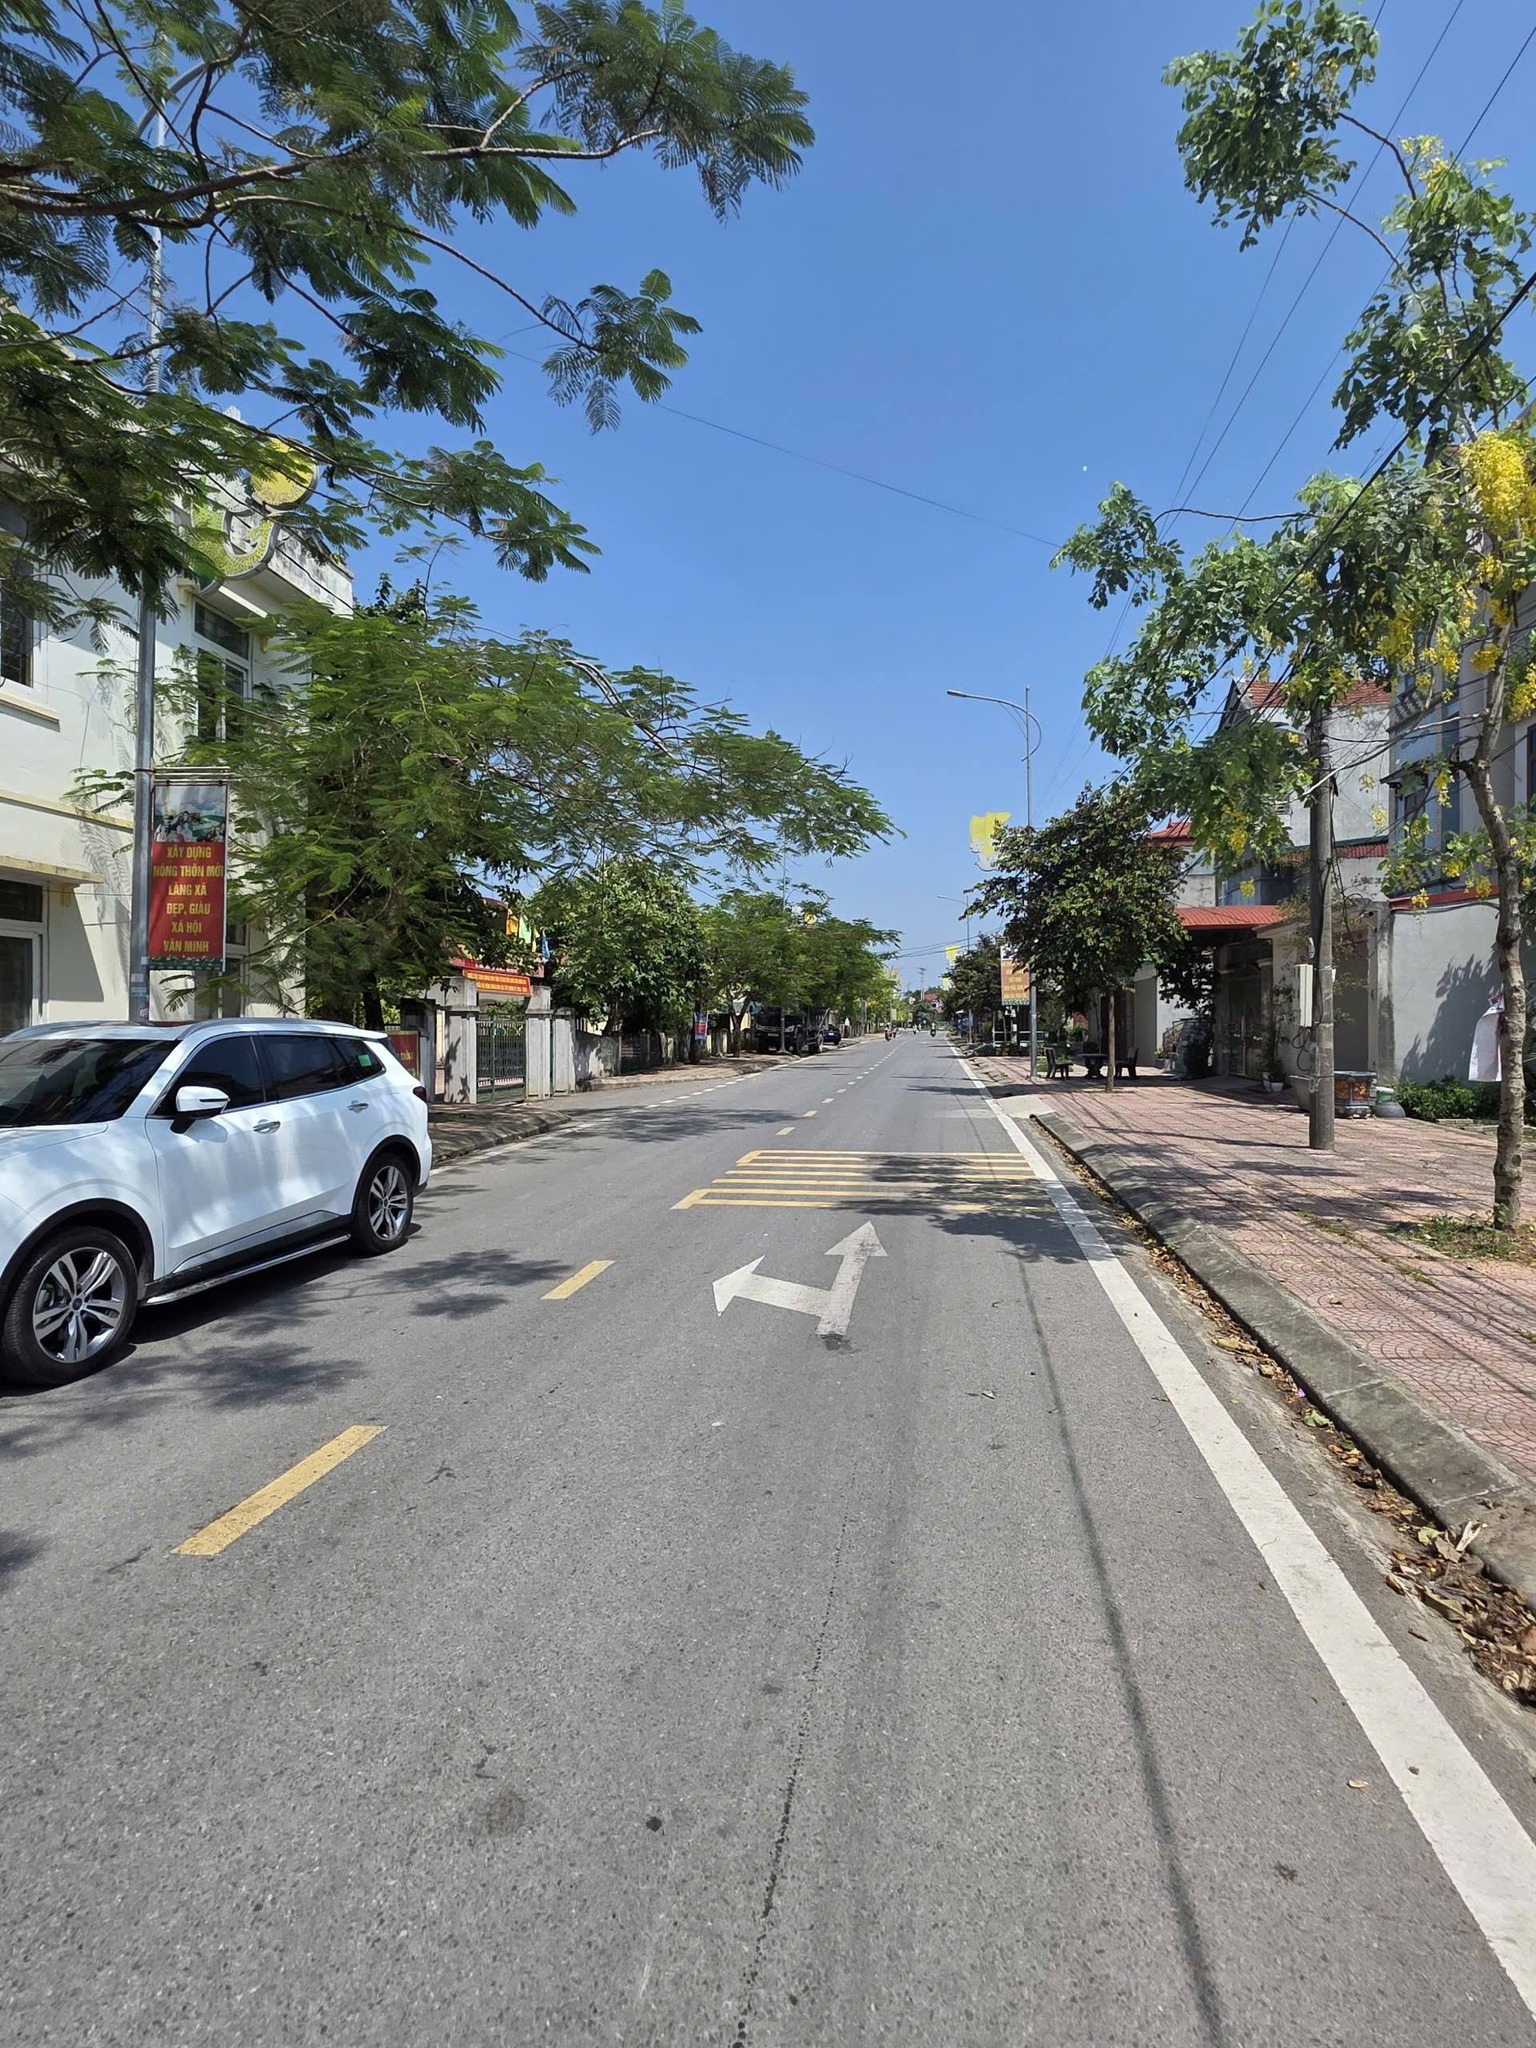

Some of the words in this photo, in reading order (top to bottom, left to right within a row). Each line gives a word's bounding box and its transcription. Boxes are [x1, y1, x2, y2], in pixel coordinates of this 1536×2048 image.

[167, 844, 184, 858] XÂY
[186, 845, 212, 861] DỰNG
[153, 863, 178, 877] NÔNG
[180, 863, 204, 877] THÔN
[206, 862, 224, 877] MỚI
[168, 881, 192, 896] LÀNG
[194, 881, 207, 896] XÃ
[166, 903, 187, 917] ĐẸP,
[189, 901, 211, 915] GIÀU
[171, 920, 184, 933] XÃ
[186, 920, 202, 936] HỘI
[163, 938, 182, 952] VĂN
[184, 940, 209, 953] MINH
